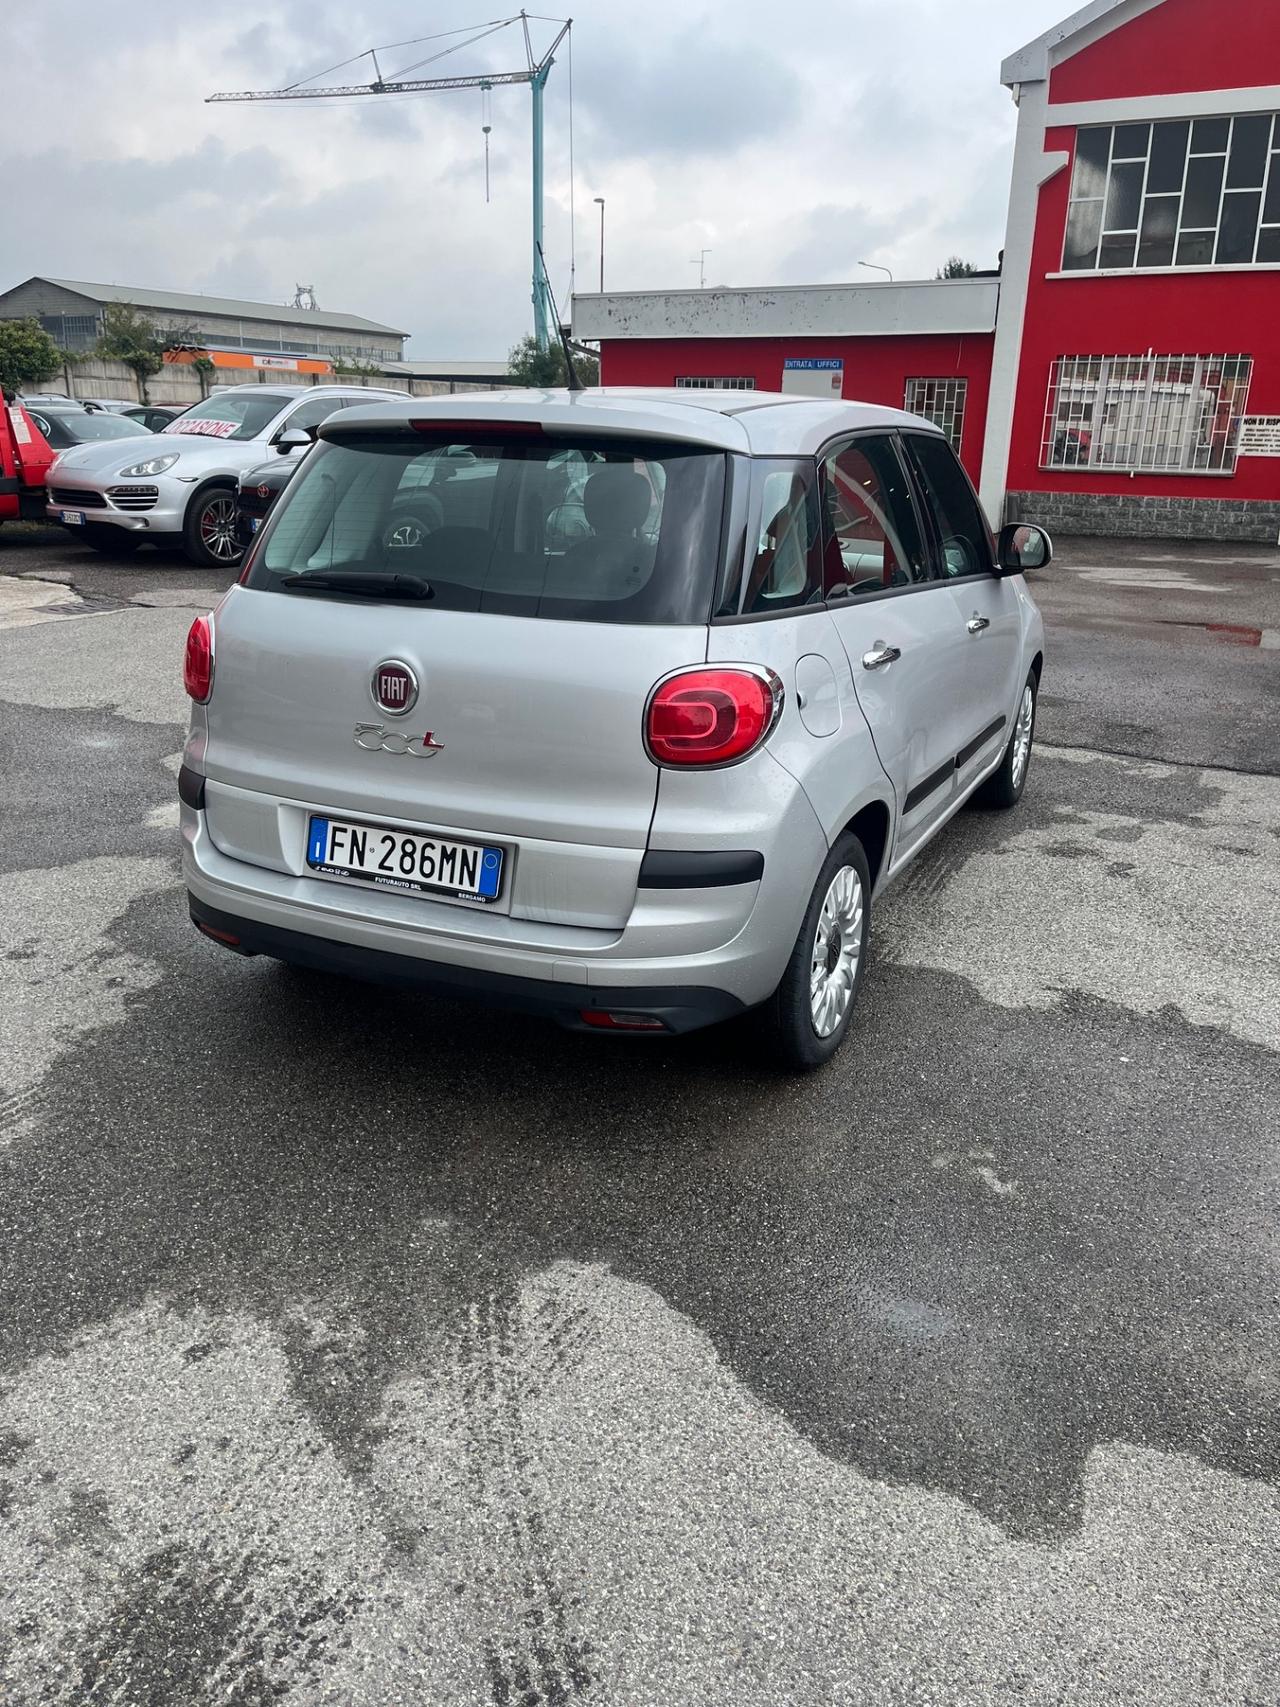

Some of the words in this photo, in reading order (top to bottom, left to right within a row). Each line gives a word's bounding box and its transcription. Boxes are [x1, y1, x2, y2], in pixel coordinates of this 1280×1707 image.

[785, 360, 812, 368] ENTRATA
[817, 360, 839, 368] UFFICI
[381, 675, 407, 701] FIAT
[378, 834, 479, 888] 286MN
[375, 876, 410, 888] FUTURAUTO
[410, 883, 422, 891] SRL
[458, 892, 486, 902] BERGAMO
